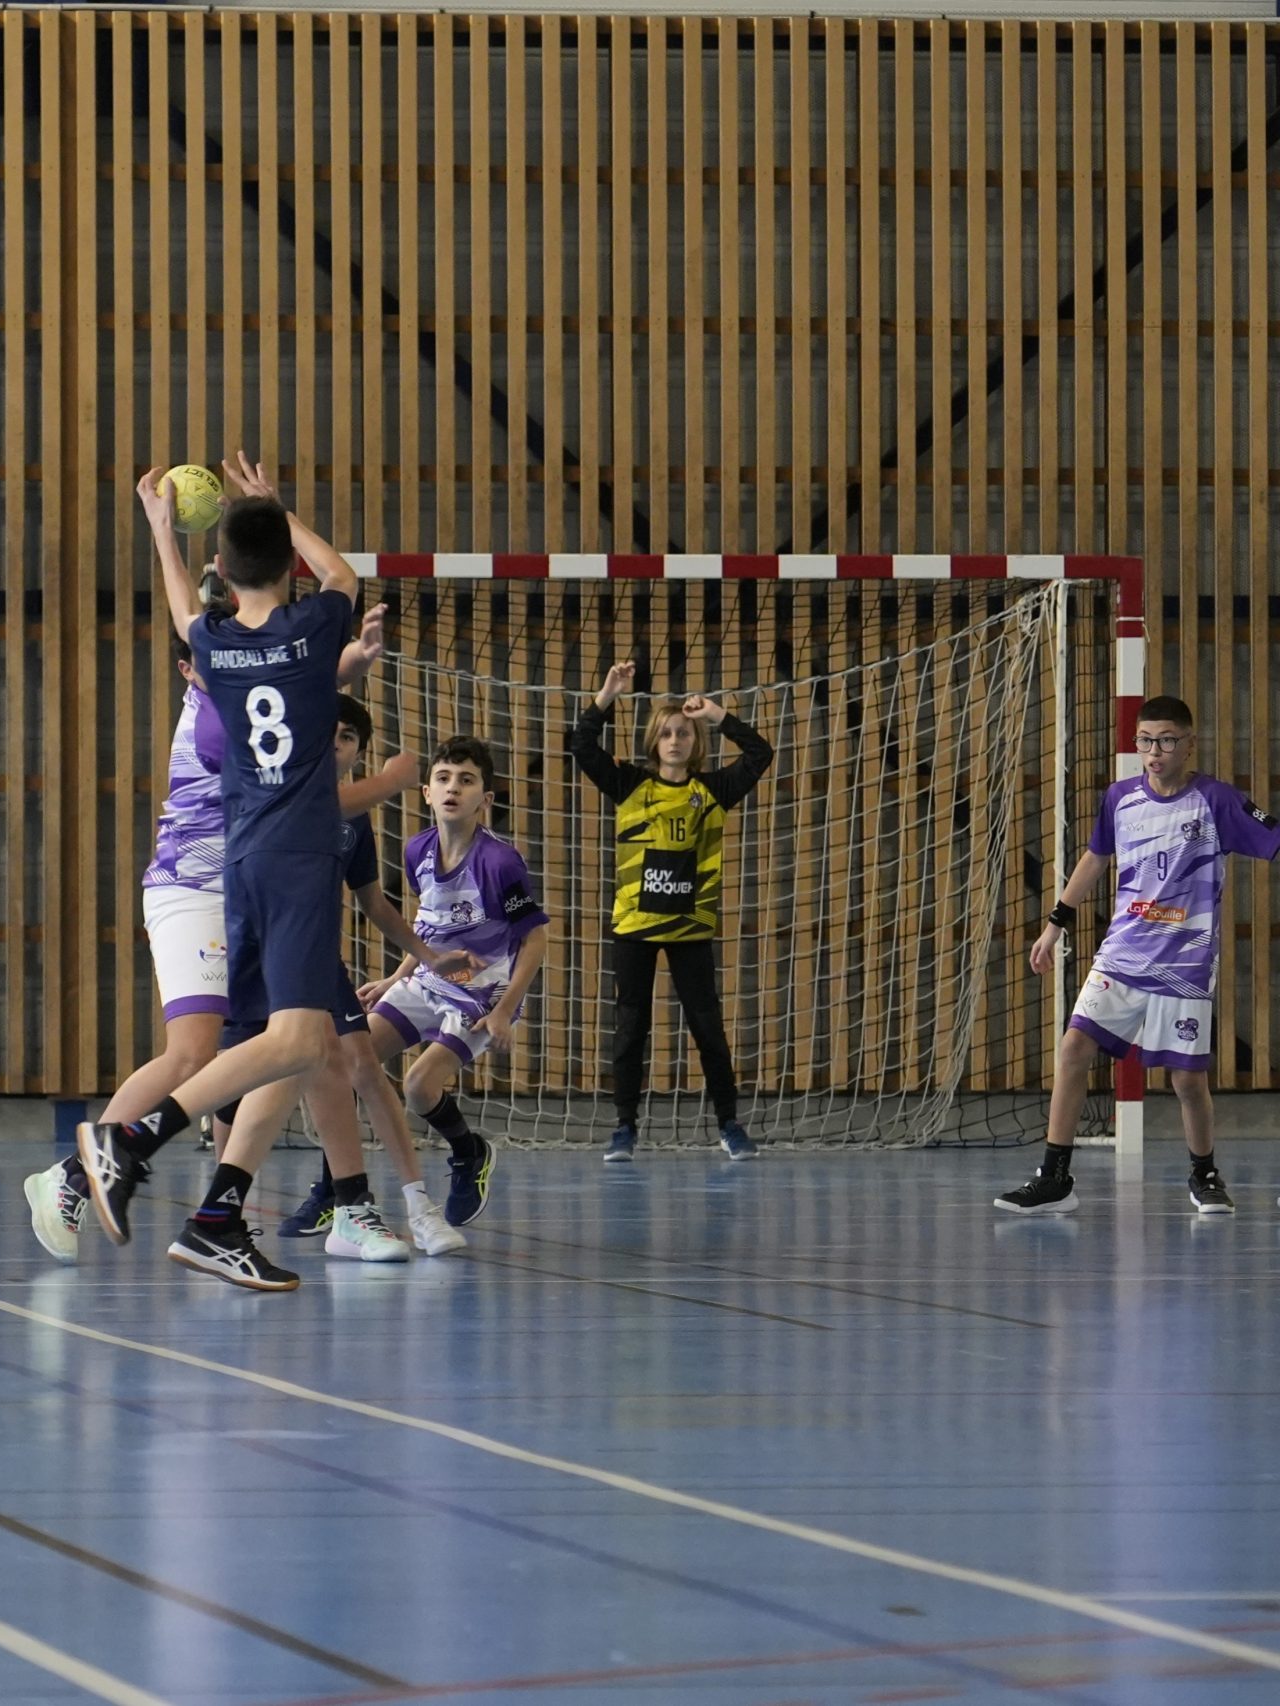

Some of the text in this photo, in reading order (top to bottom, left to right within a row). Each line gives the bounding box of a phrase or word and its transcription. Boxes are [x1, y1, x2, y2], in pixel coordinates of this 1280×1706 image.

[210, 649, 264, 669] HANDBALL
[246, 685, 293, 768] 8
[669, 818, 686, 842] 16
[644, 868, 673, 881] GUY
[1157, 851, 1168, 881] 9
[1149, 906, 1182, 921] Fouille
